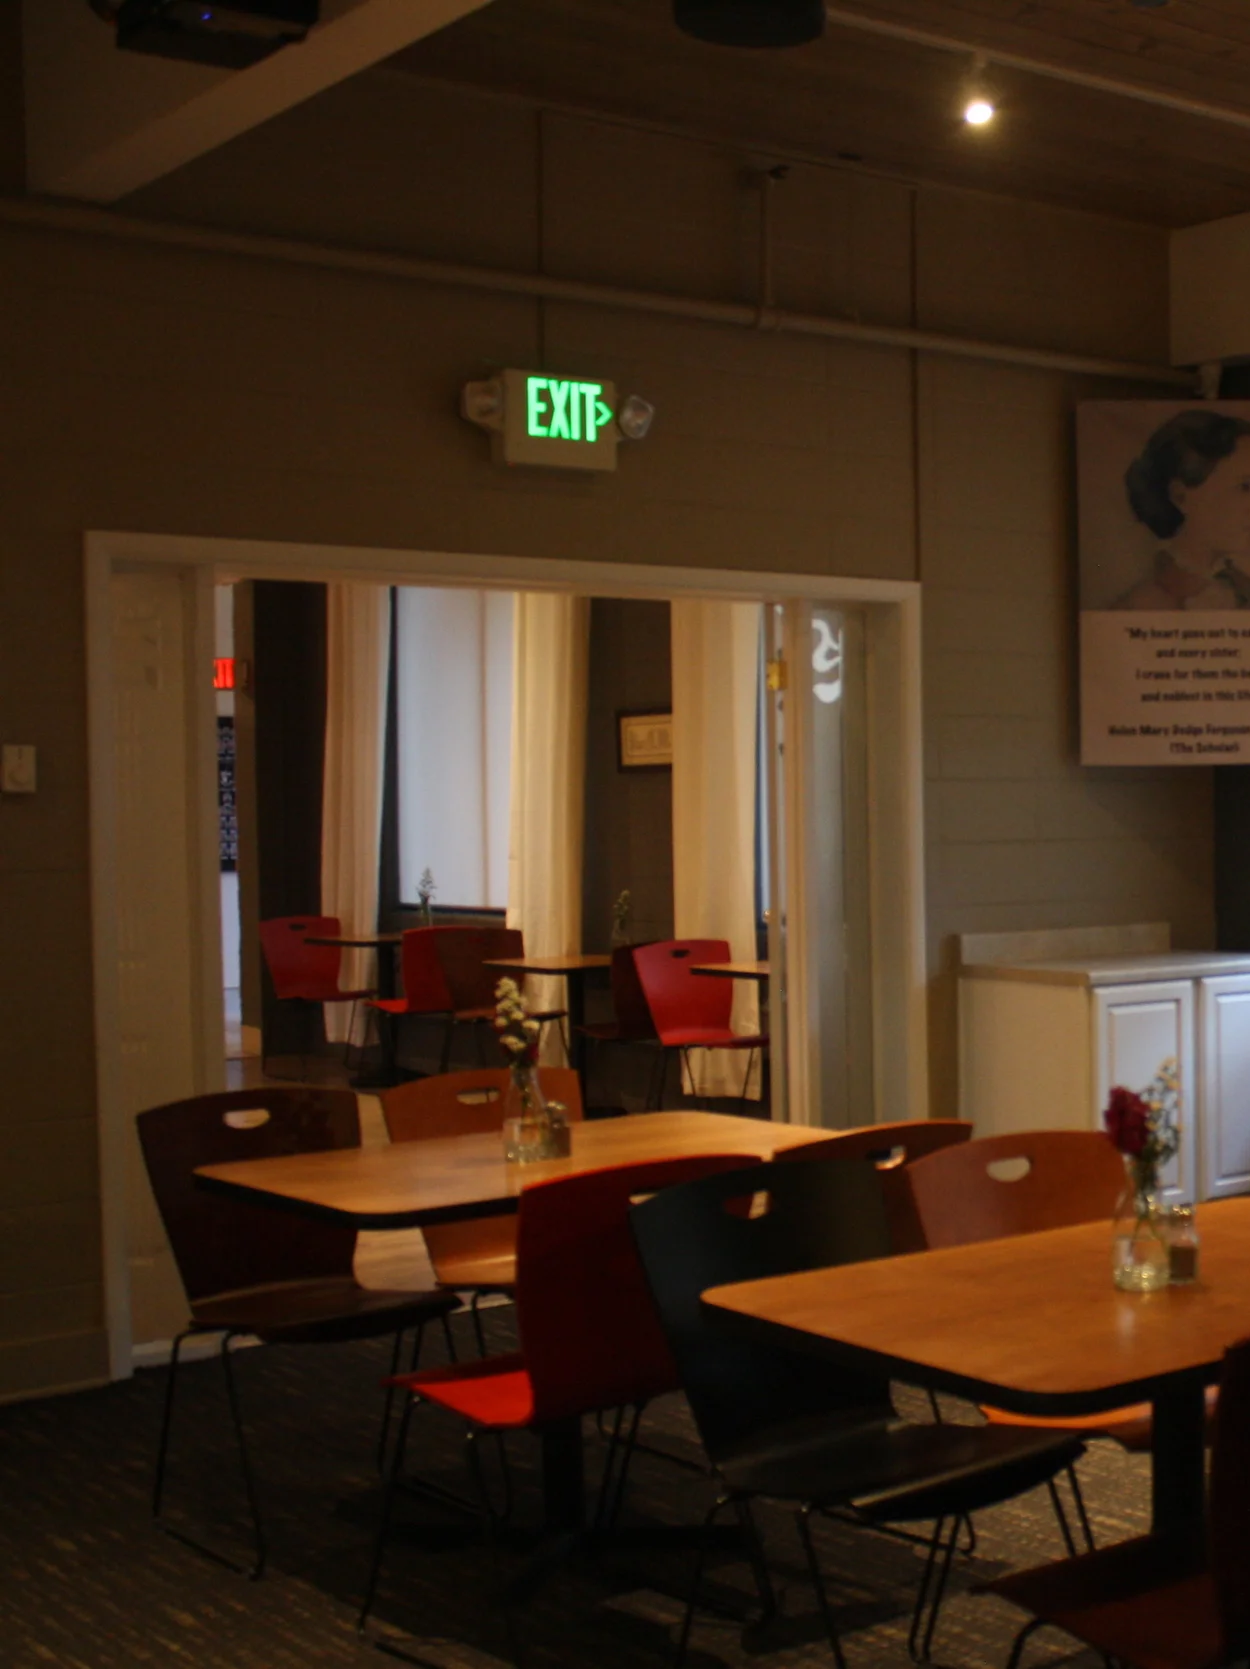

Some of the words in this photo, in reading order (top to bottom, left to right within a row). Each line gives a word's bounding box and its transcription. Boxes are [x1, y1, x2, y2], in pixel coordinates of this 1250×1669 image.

[527, 376, 602, 442] EXIT
[1124, 626, 1148, 641] "My
[1150, 627, 1179, 639] heart
[1182, 629, 1205, 641] goes
[1207, 628, 1226, 639] out
[1228, 627, 1239, 639] to
[1156, 648, 1176, 658] and
[1178, 649, 1207, 660] every
[1135, 668, 1141, 680] I
[1174, 668, 1188, 680] for
[1192, 668, 1219, 680] them
[1222, 667, 1239, 679] the
[1141, 689, 1160, 702] and
[1163, 689, 1200, 702] noblest
[1202, 690, 1213, 702] in
[1215, 690, 1235, 702] this
[1108, 723, 1137, 736] Helen
[1139, 723, 1169, 736] Mary
[1172, 723, 1203, 737] Dodge
[1169, 741, 1193, 754] (The
[1196, 741, 1240, 754] Scholar)
